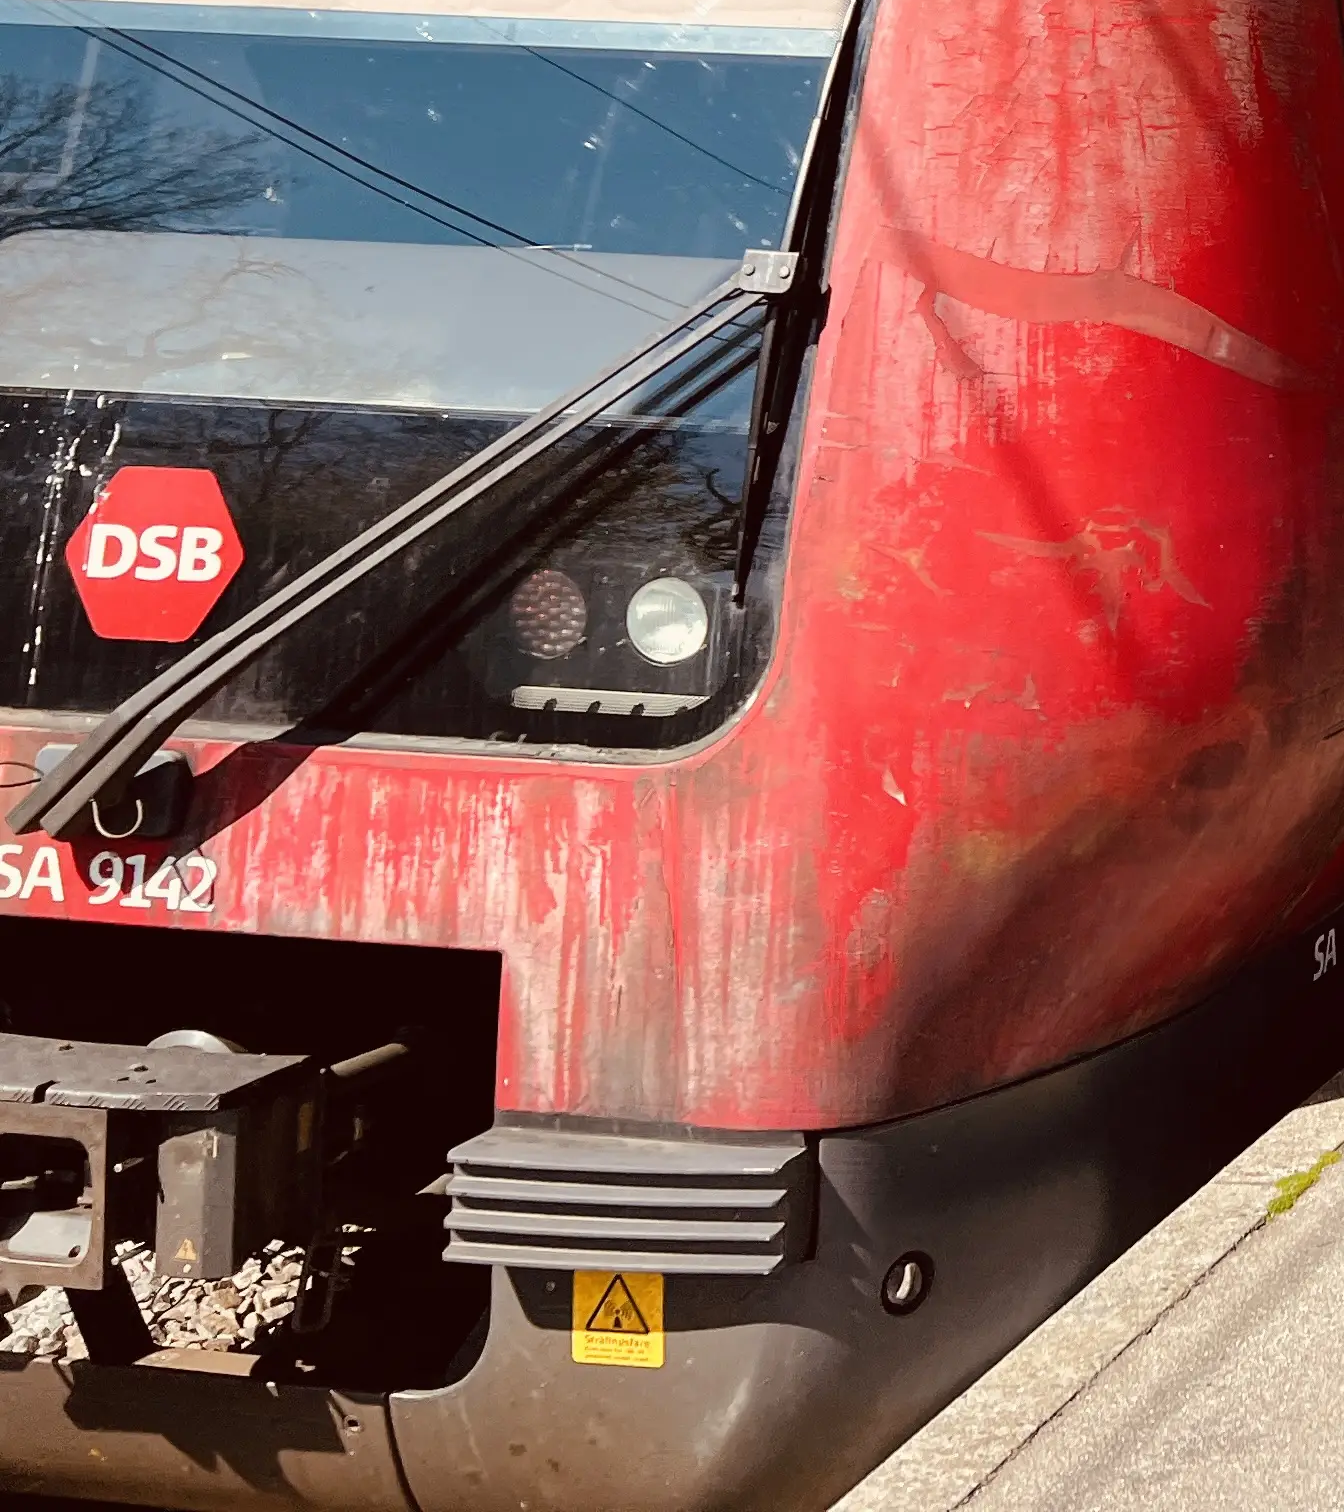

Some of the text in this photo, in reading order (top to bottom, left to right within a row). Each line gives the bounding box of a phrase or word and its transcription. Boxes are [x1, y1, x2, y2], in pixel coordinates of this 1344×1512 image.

[86, 523, 223, 582] DSB
[0, 844, 218, 912] SA 9142
[1313, 928, 1337, 981] SA
